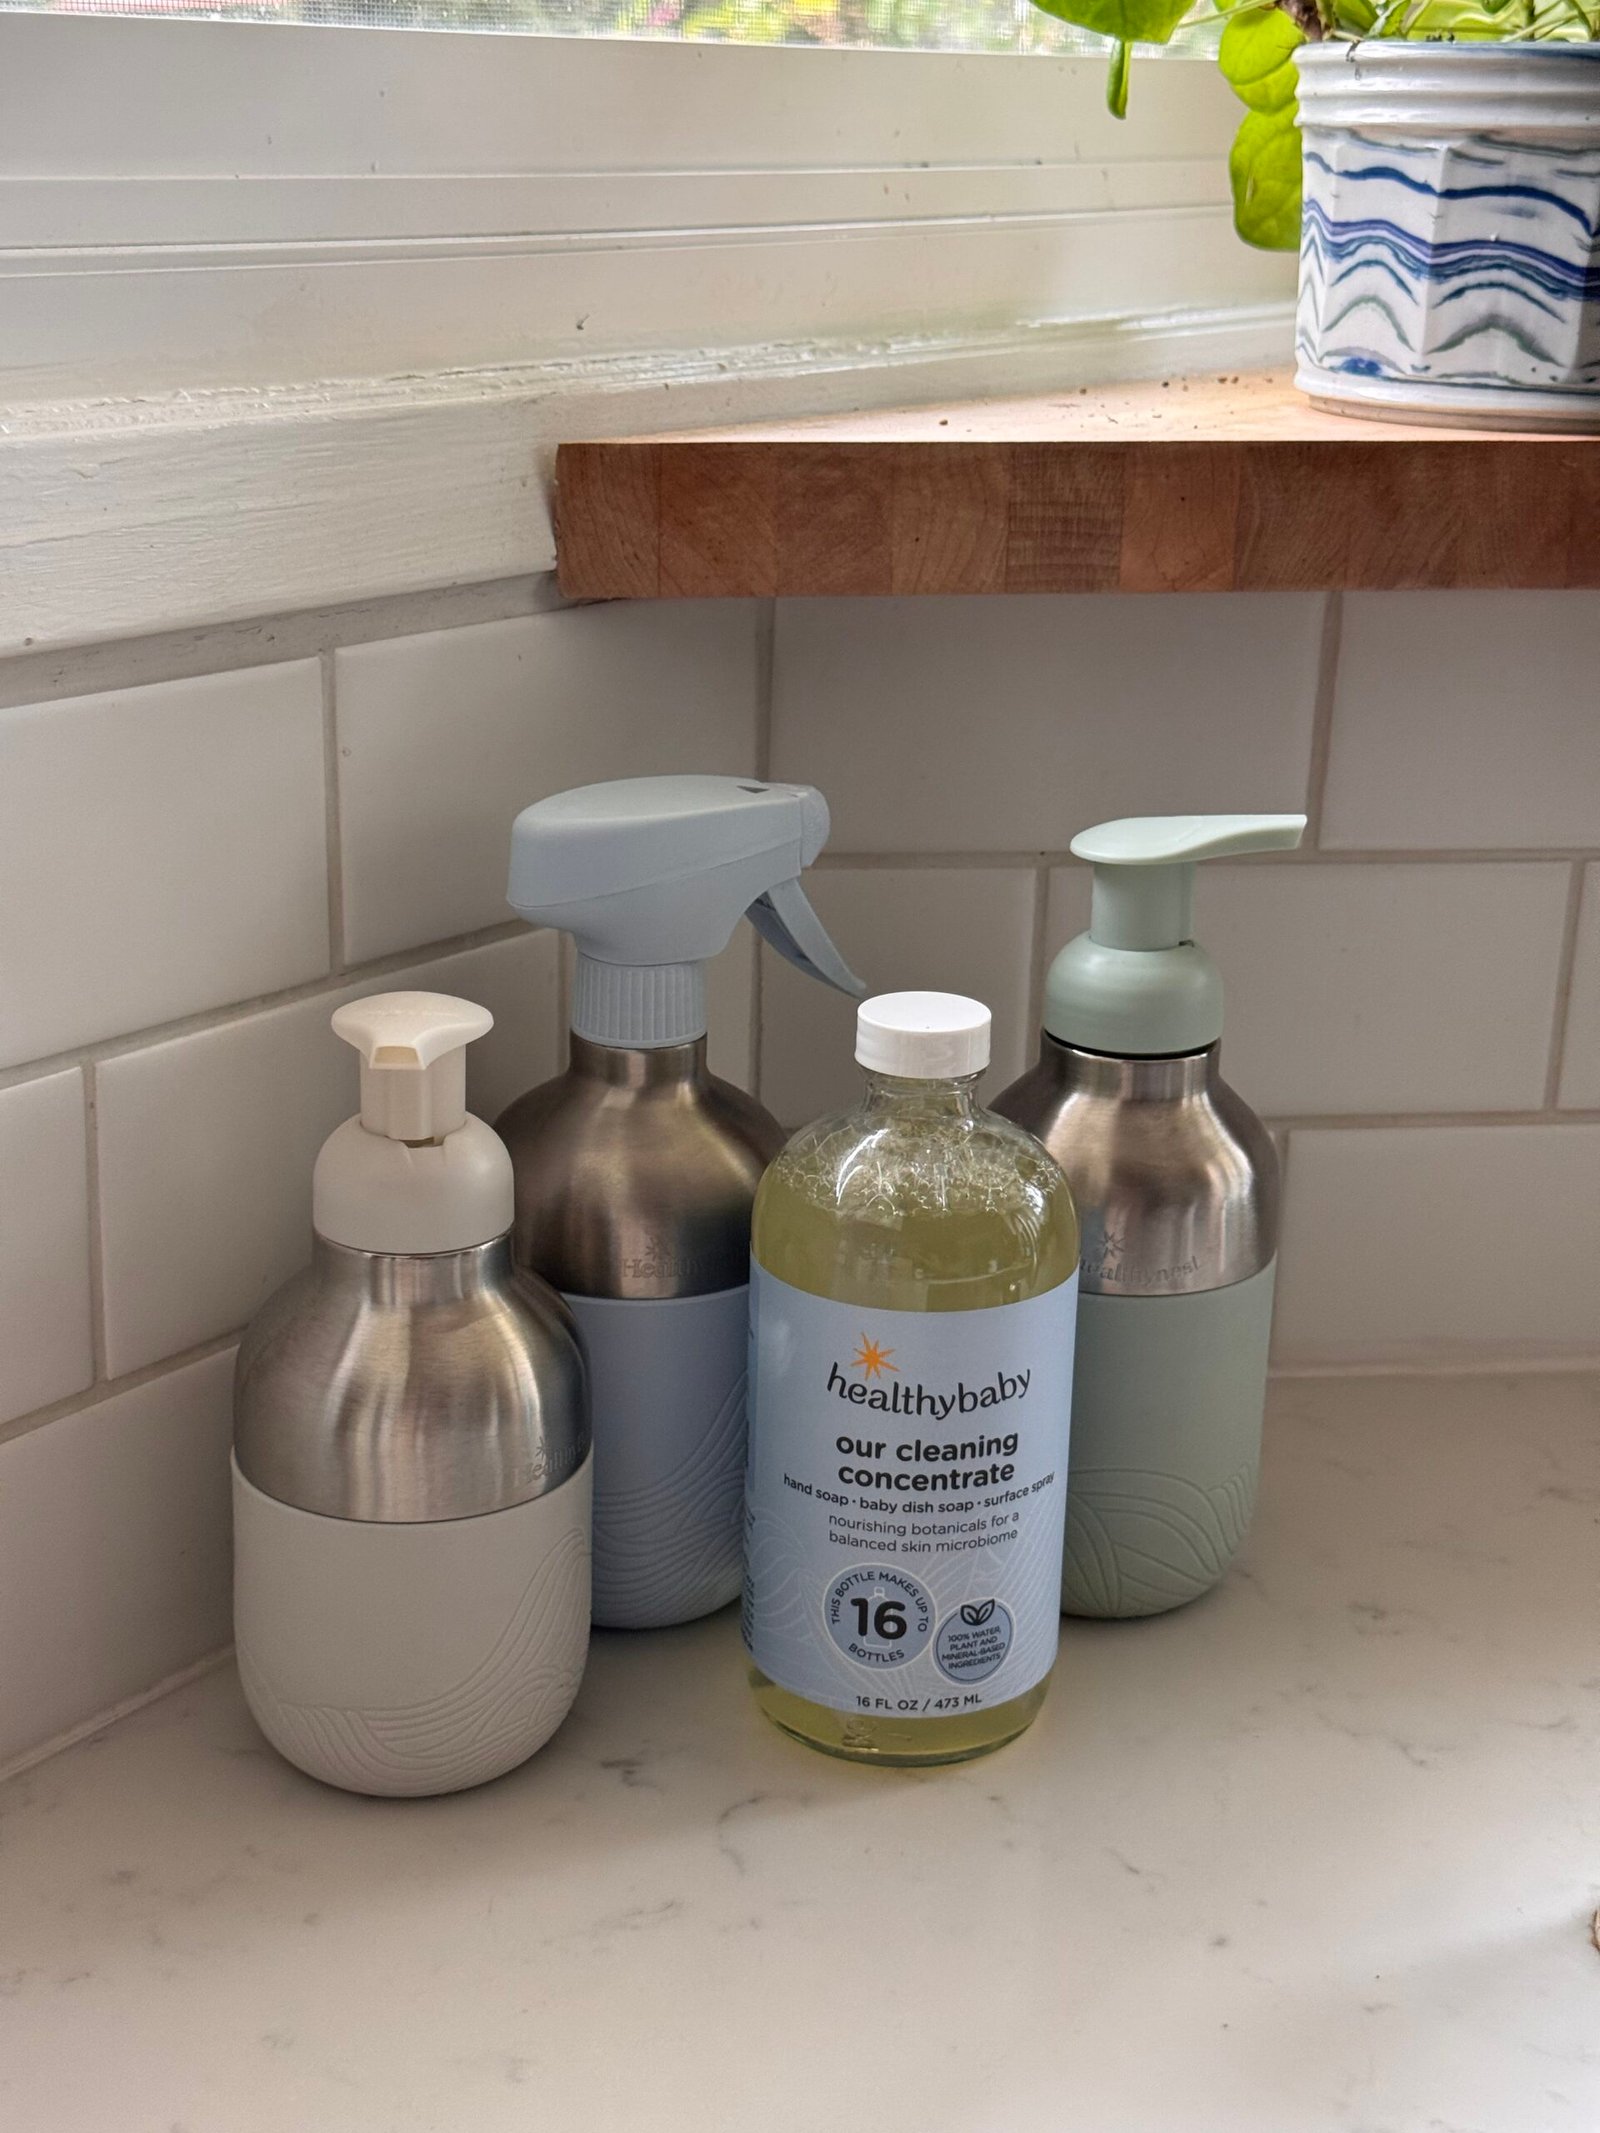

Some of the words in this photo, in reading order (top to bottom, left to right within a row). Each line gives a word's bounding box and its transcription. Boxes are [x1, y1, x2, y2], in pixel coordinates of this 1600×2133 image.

[827, 1362, 1031, 1420] healthybaby
[836, 1436, 886, 1459] our
[896, 1432, 1018, 1462] cleaning
[838, 1463, 1015, 1491] concentrate
[783, 1473, 812, 1496] hand
[816, 1488, 848, 1507] soap
[859, 1497, 896, 1514] baby
[902, 1501, 933, 1513] dish
[938, 1500, 974, 1513] soap
[984, 1486, 1029, 1508] surface
[1031, 1470, 1055, 1493] spray
[828, 1515, 906, 1536] nourishing
[911, 1518, 986, 1535] botanicals
[990, 1515, 1009, 1527] for
[1012, 1511, 1020, 1521] a
[829, 1530, 896, 1551] balanced
[902, 1541, 931, 1553] skin
[936, 1529, 1017, 1551] microbiome
[835, 1571, 875, 1598] BOTTLE
[879, 1571, 918, 1597] MAKES
[831, 1598, 841, 1624] THIS
[915, 1597, 928, 1613] UP
[851, 1598, 907, 1640] 16
[917, 1616, 929, 1632] TO
[948, 1632, 970, 1642] 100%
[950, 1641, 977, 1651] PLANT
[980, 1636, 998, 1645] AND
[848, 1643, 905, 1662] BOTTLES
[942, 1642, 1005, 1660] MINERAL-BASED
[948, 1652, 1000, 1669] INGREDIENTS
[856, 1695, 870, 1707] 16
[875, 1697, 893, 1710] FL
[897, 1699, 918, 1711] OZ
[934, 1696, 960, 1709] 473
[964, 1694, 982, 1705] ML
